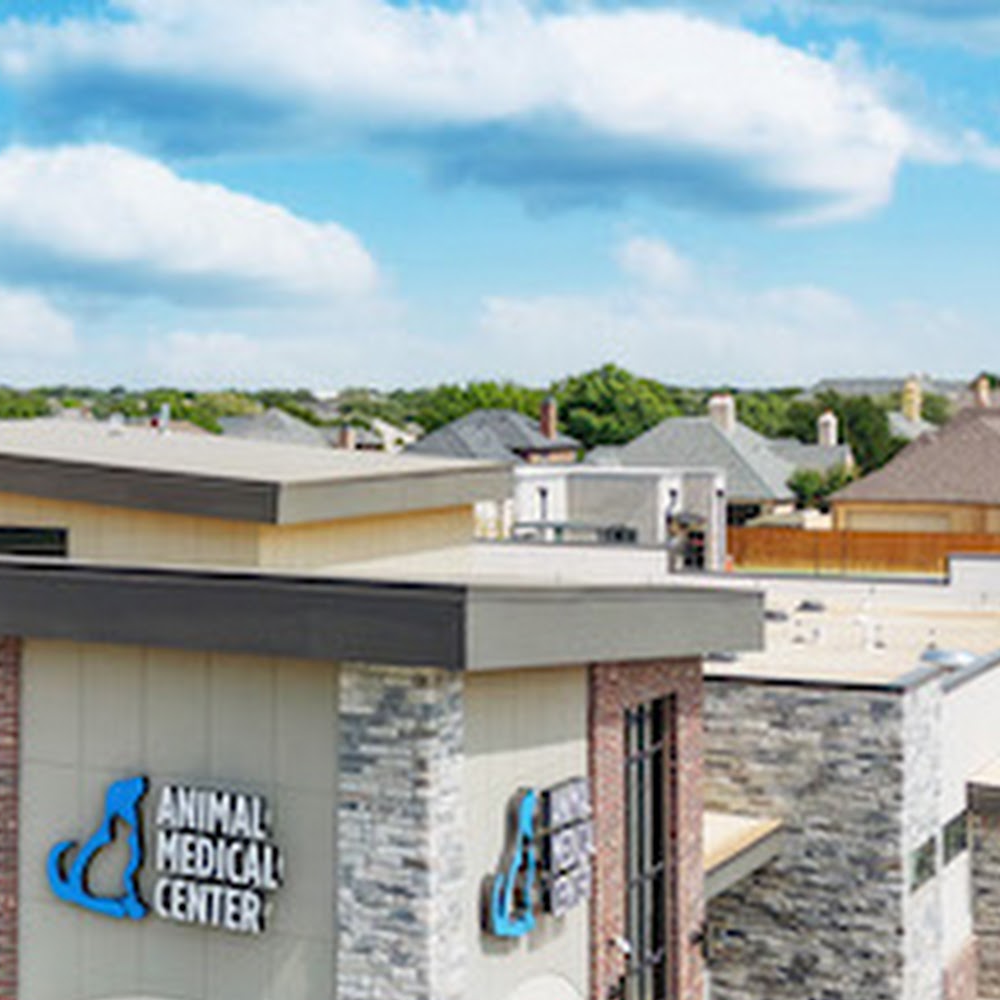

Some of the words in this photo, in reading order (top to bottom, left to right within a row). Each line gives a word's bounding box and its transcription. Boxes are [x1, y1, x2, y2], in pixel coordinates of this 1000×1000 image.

[156, 785, 268, 839] ANIMAL
[156, 830, 280, 890] MEDICAL
[154, 877, 263, 933] CENTER
